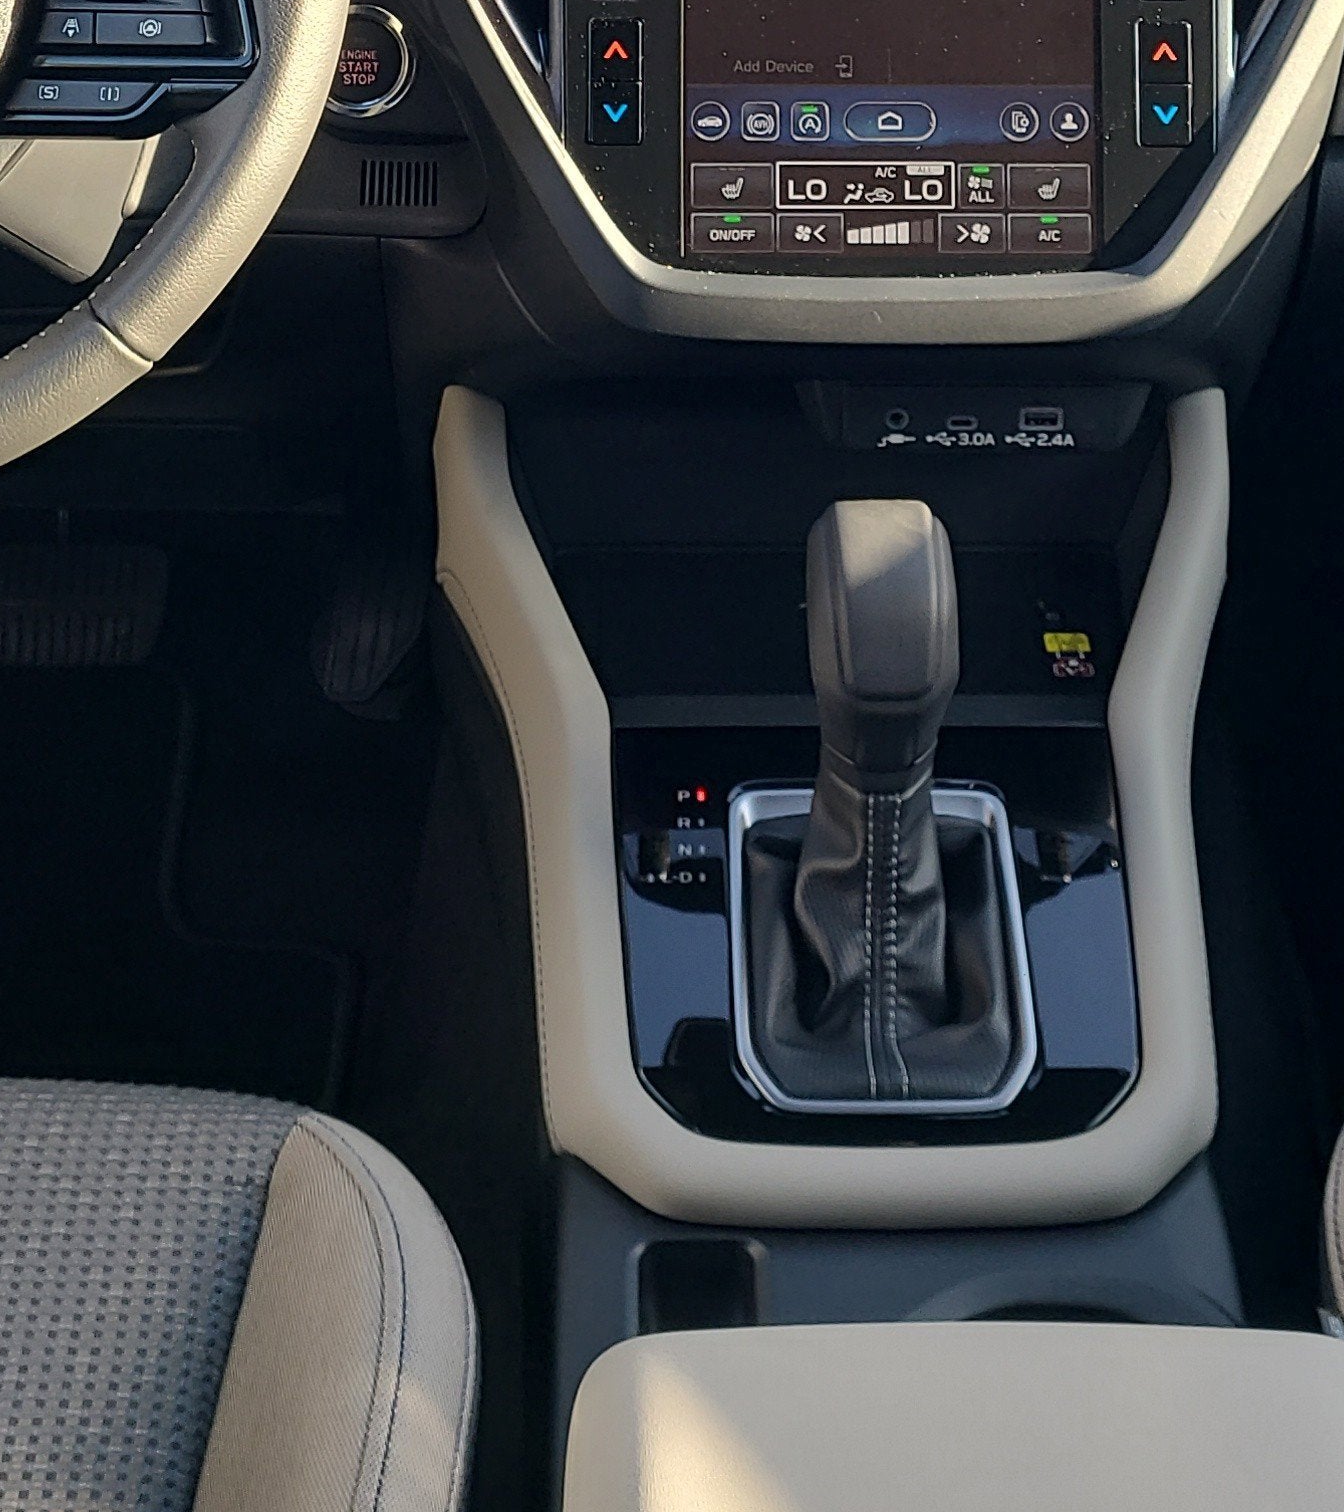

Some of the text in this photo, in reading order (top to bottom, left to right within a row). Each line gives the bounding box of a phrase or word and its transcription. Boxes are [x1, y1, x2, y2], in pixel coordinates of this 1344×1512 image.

[341, 49, 378, 59] ENGINE
[339, 61, 380, 73] START
[733, 60, 814, 74] Add Device
[343, 73, 376, 85] STOP
[875, 166, 897, 179] A/C
[788, 179, 943, 202] LO LO
[968, 191, 995, 203] ALL
[709, 230, 756, 242] ON/OFF
[1038, 230, 1061, 243] A/C
[958, 433, 996, 447] 3.0A
[1036, 433, 1075, 447] 2.4A
